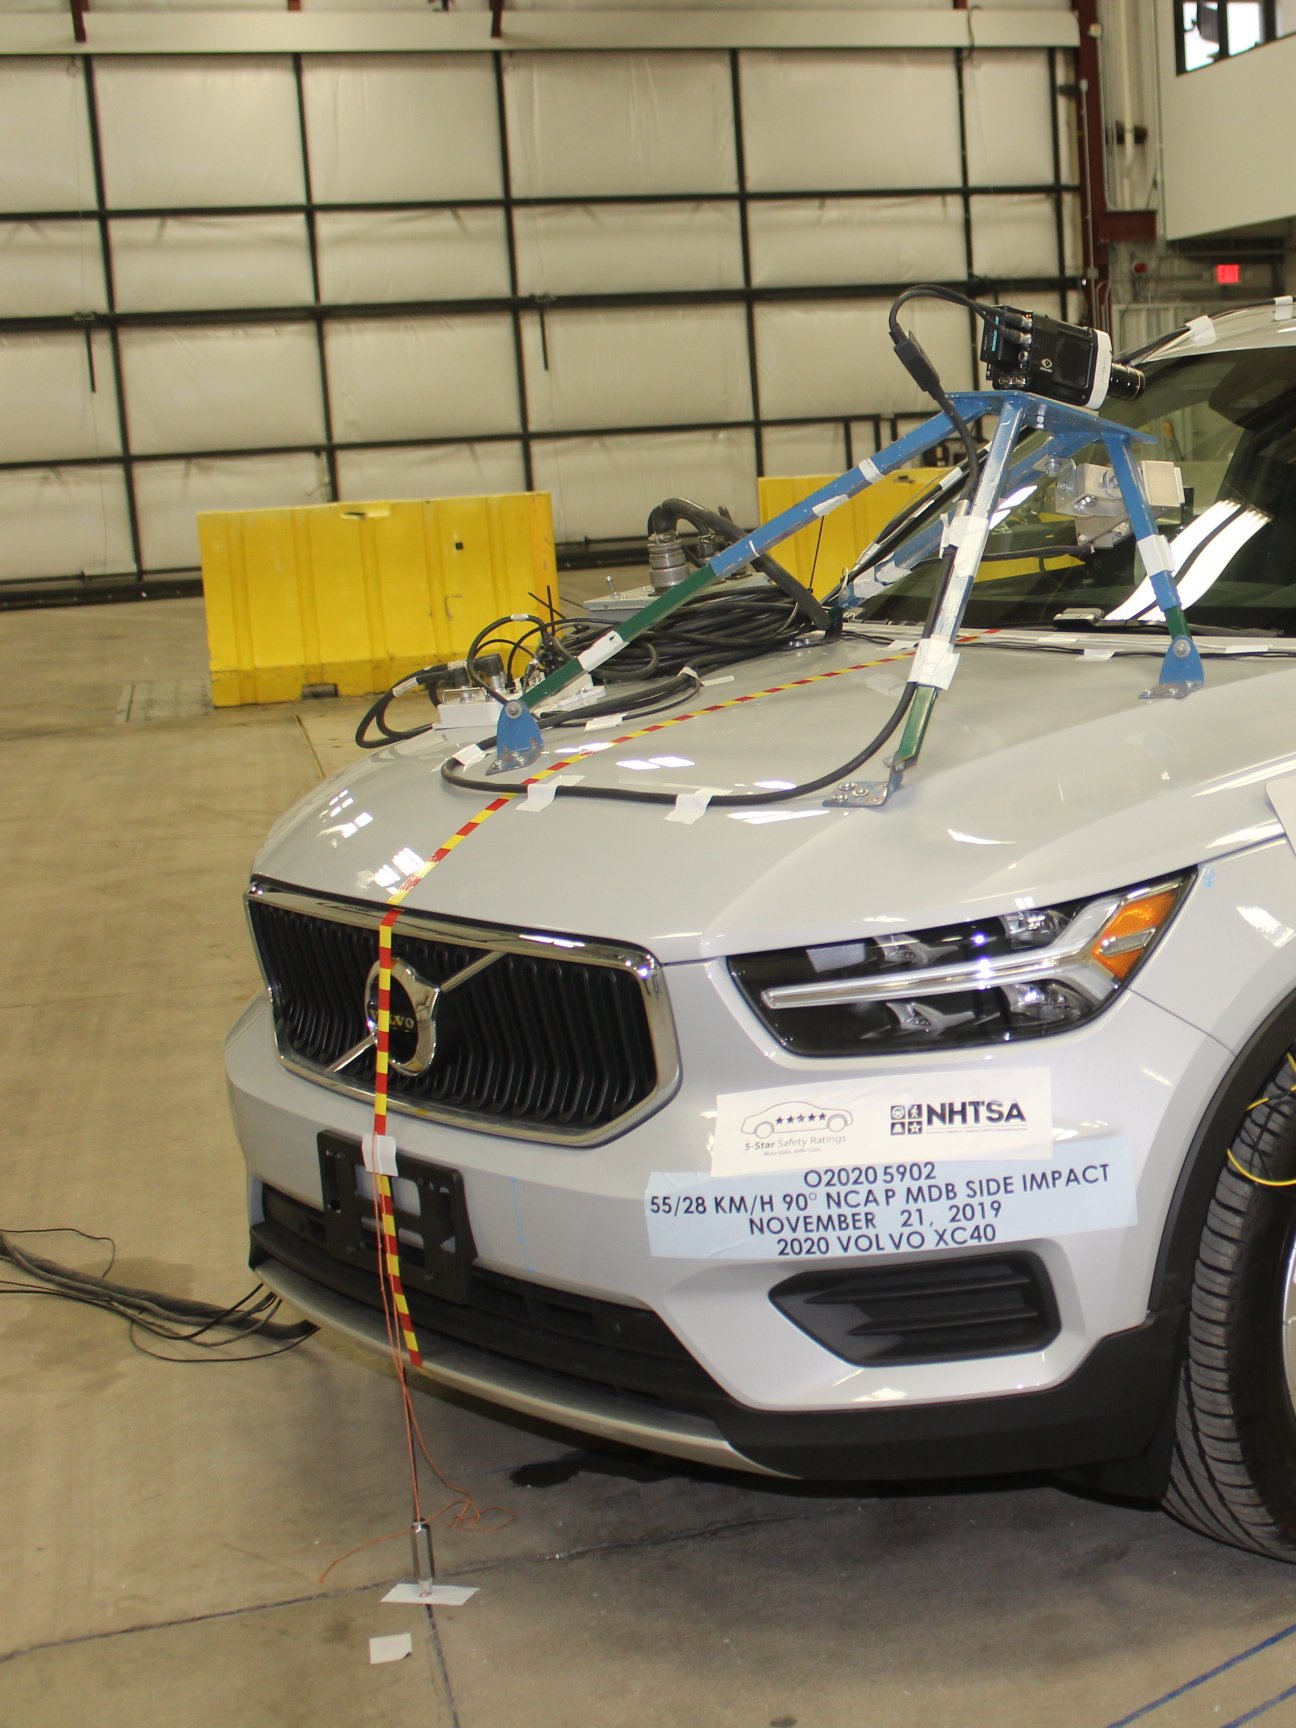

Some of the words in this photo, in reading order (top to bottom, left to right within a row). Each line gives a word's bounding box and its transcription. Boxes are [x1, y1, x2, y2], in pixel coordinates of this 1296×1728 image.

[1217, 264, 1240, 283] EXIT
[926, 1099, 1027, 1126] NHTSA
[744, 1140, 776, 1152] 5-Star
[777, 1137, 808, 1149] Safety
[810, 1134, 847, 1146] Ratings
[650, 1196, 707, 1216] 55/28
[714, 1193, 775, 1216] KM/H
[826, 1187, 896, 1209] NCAP
[905, 1182, 957, 1206] MDB
[965, 1176, 1015, 1199] SIDE
[1022, 1163, 1110, 1194] IMPACT
[749, 1212, 876, 1237] NOVEMBER
[900, 1209, 935, 1231] 21,
[948, 1200, 1002, 1224] 2019
[777, 1237, 830, 1258] 2020
[837, 1231, 925, 1255] VOLVO
[935, 1224, 997, 1247] XC40
